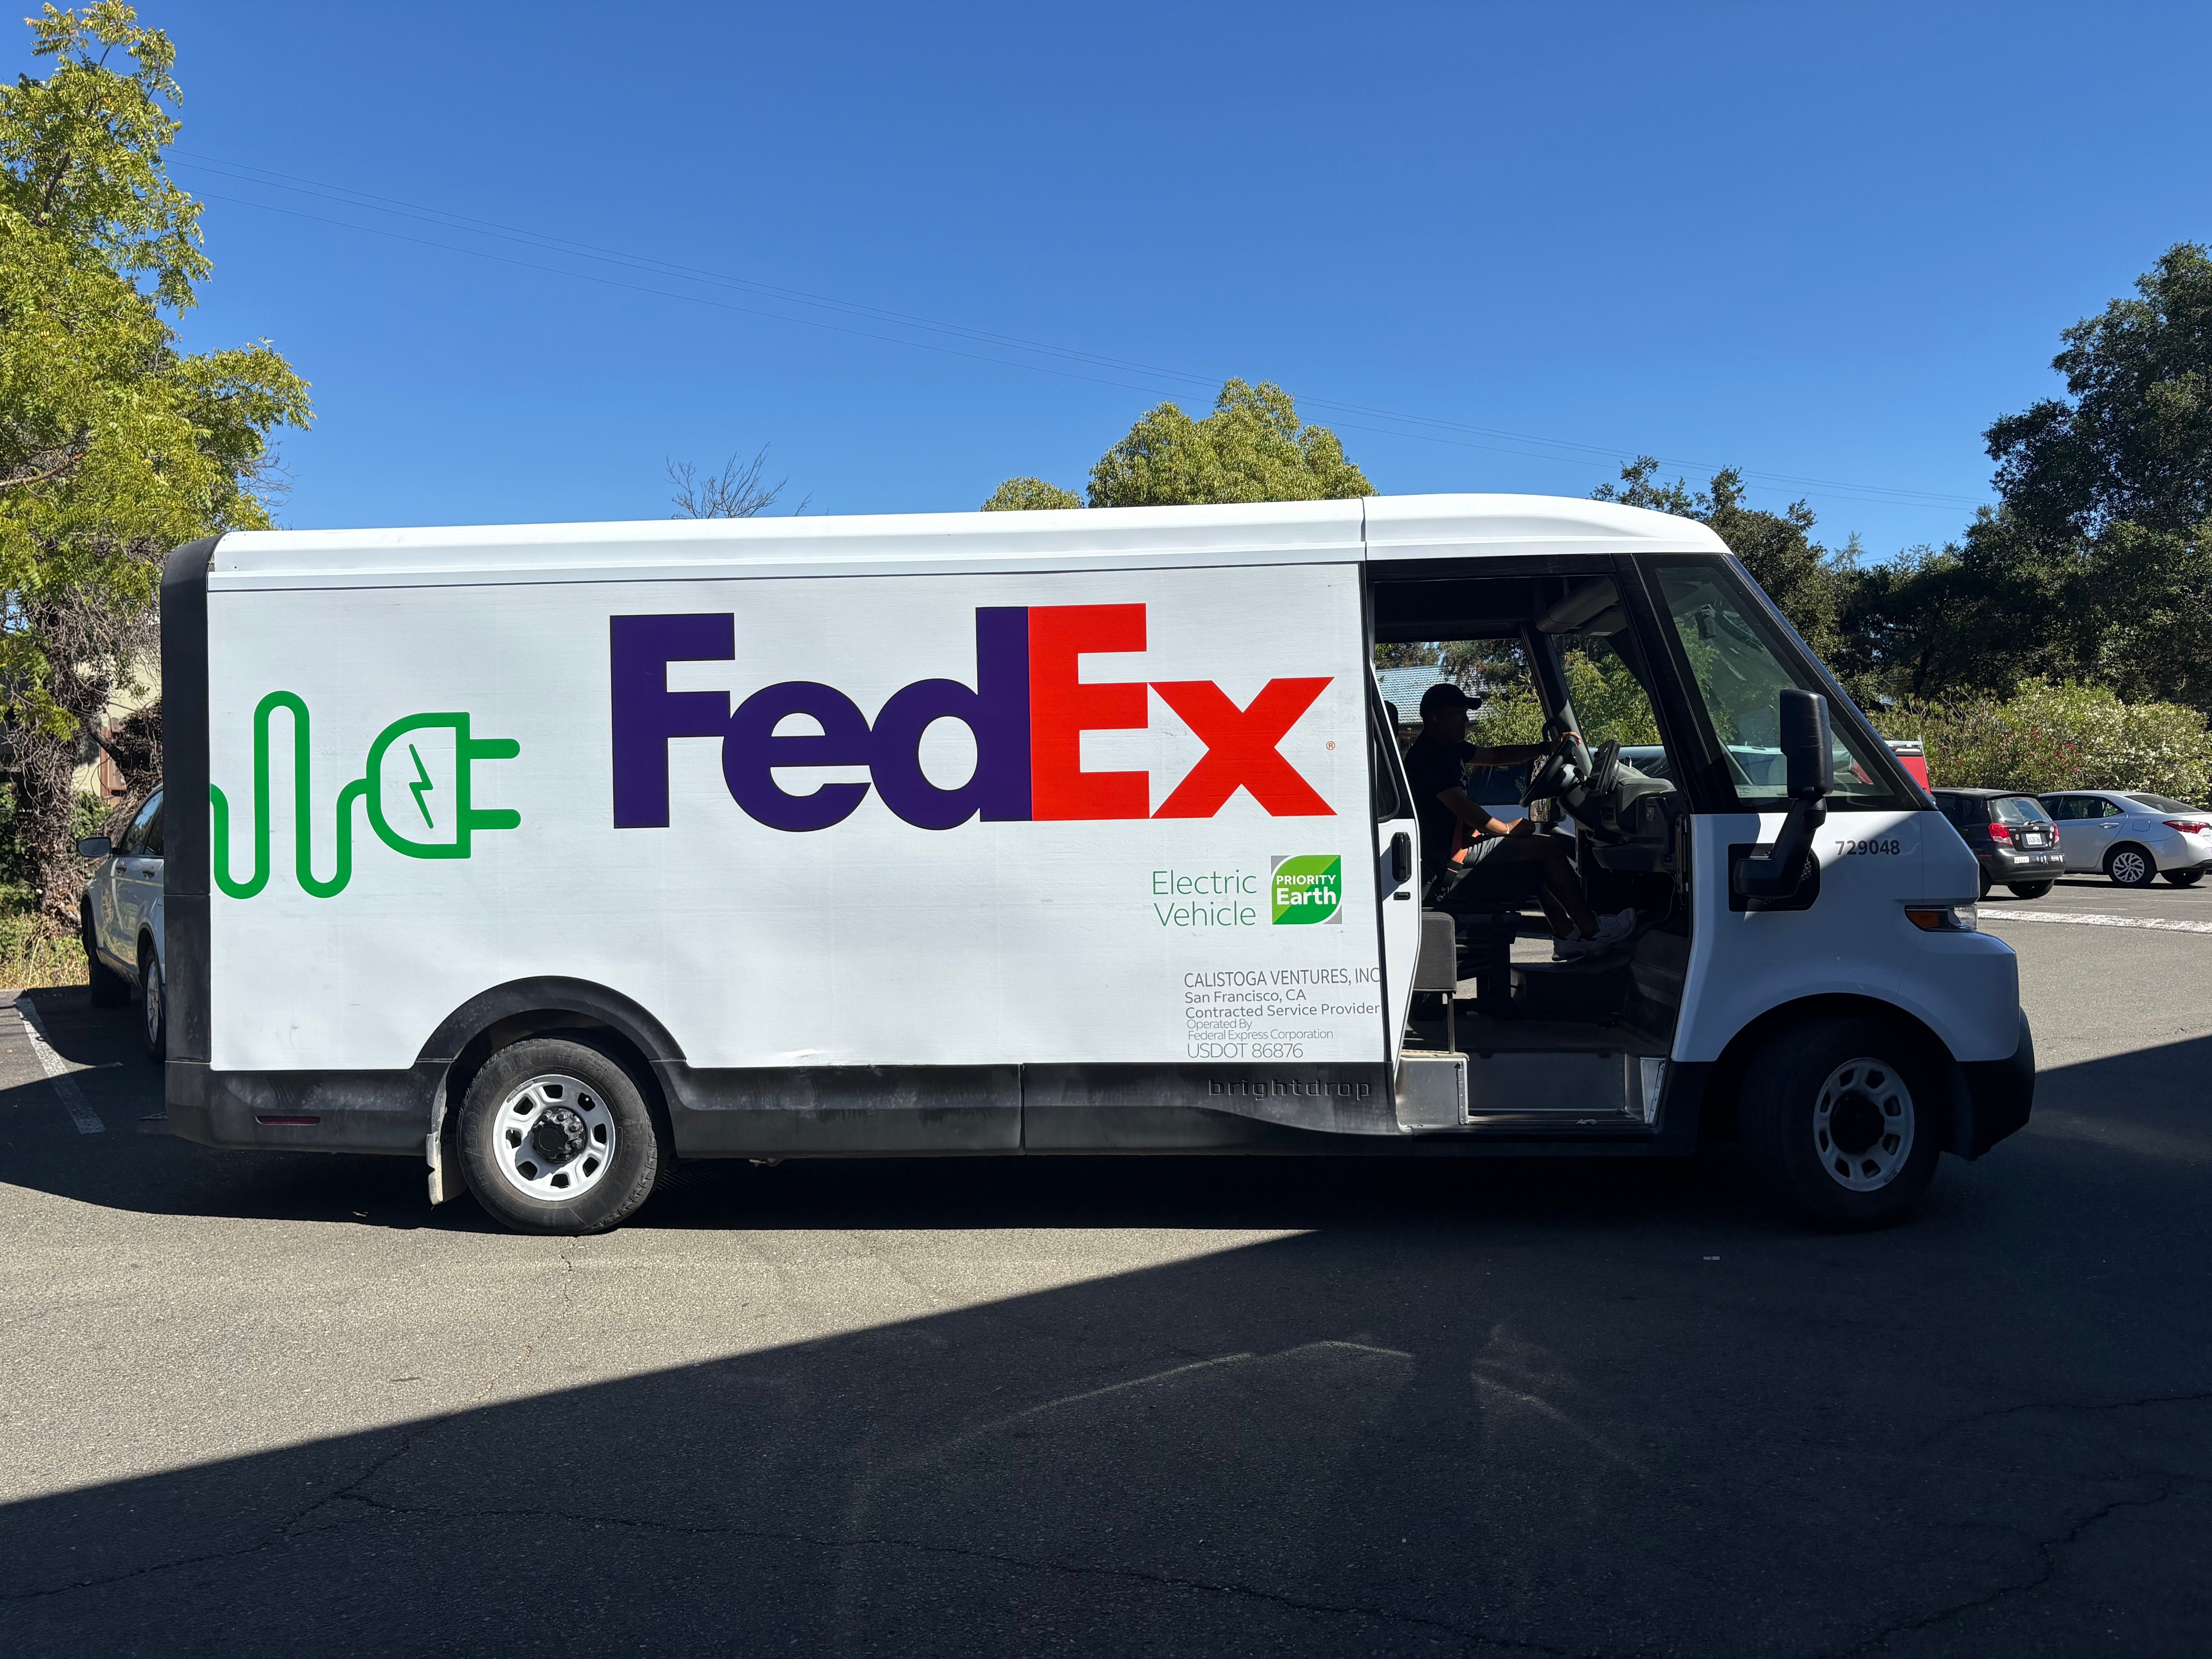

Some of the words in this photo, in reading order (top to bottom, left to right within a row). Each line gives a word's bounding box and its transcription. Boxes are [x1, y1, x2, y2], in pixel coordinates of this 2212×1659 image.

[610, 603, 1337, 832] FedEx
[1835, 840, 1900, 855] 729048
[1153, 869, 1257, 895] Electric
[1277, 875, 1336, 884] PRIORITY
[1277, 887, 1336, 905] Earth
[1154, 900, 1255, 926] Vehicle
[1184, 971, 1267, 988] CALISTOGA
[1270, 969, 1351, 986] VENTURES,
[1355, 967, 1380, 984] INC
[1185, 992, 1210, 1003] San
[1214, 990, 1282, 1003] Francisco,
[1286, 989, 1306, 1000] CA
[1186, 1006, 1262, 1018] Contracted
[1267, 1004, 1317, 1016] Service
[1322, 1002, 1380, 1015] Provider
[1187, 1019, 1236, 1030] Operated
[1240, 1019, 1252, 1030] By
[1188, 1029, 1225, 1040] Federal
[1228, 1029, 1268, 1042] Express
[1271, 1029, 1333, 1041] Corporation
[1188, 1043, 1248, 1058] USDOT
[1252, 1043, 1303, 1058] 86876
[1209, 1079, 1371, 1101] brightdrop
